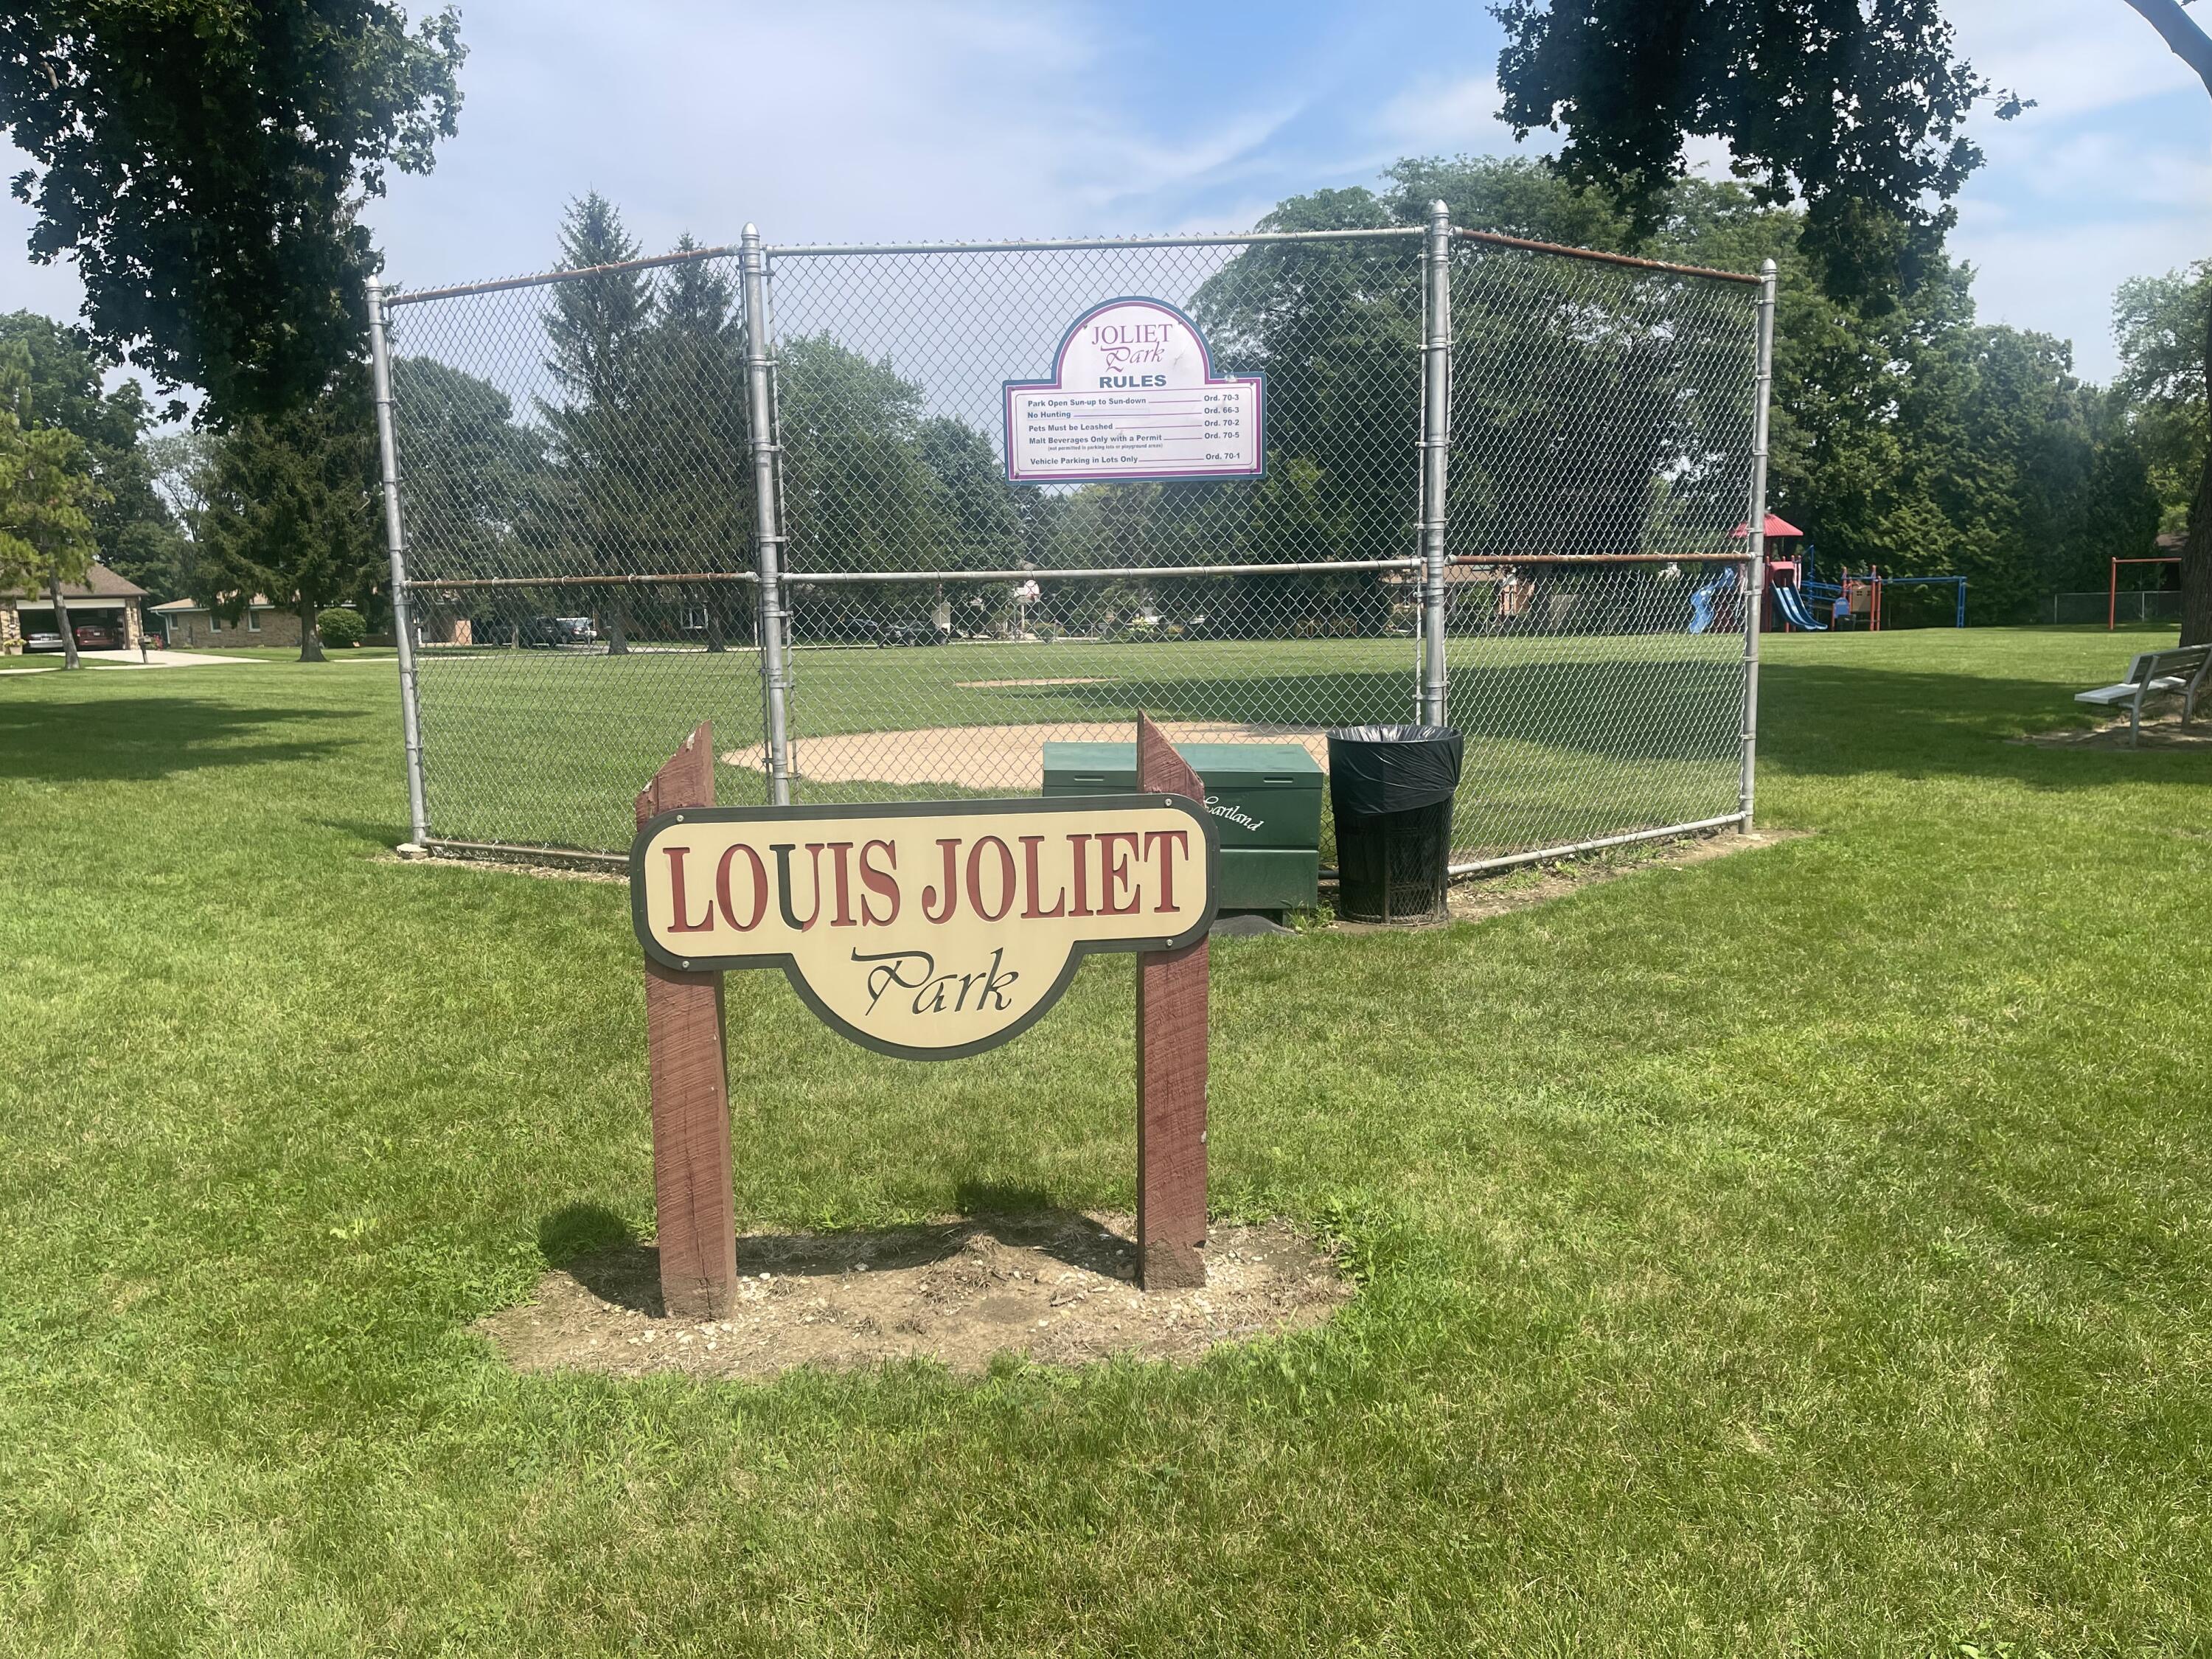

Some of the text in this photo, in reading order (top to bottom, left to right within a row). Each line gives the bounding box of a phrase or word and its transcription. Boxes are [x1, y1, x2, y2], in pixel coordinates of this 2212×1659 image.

[1091, 324, 1173, 345] JOLIET
[1100, 341, 1165, 373] Park
[1099, 375, 1167, 389] RULES
[1048, 400, 1068, 408] Open
[1070, 399, 1096, 407] Sun-up
[1048, 437, 1088, 445] Beverages
[1030, 457, 1058, 465] Vehicle
[1060, 456, 1090, 465] Parking
[1121, 455, 1138, 464] Only
[663, 830, 1189, 933] LOUIS JOLIET
[852, 947, 1019, 1016] Park
